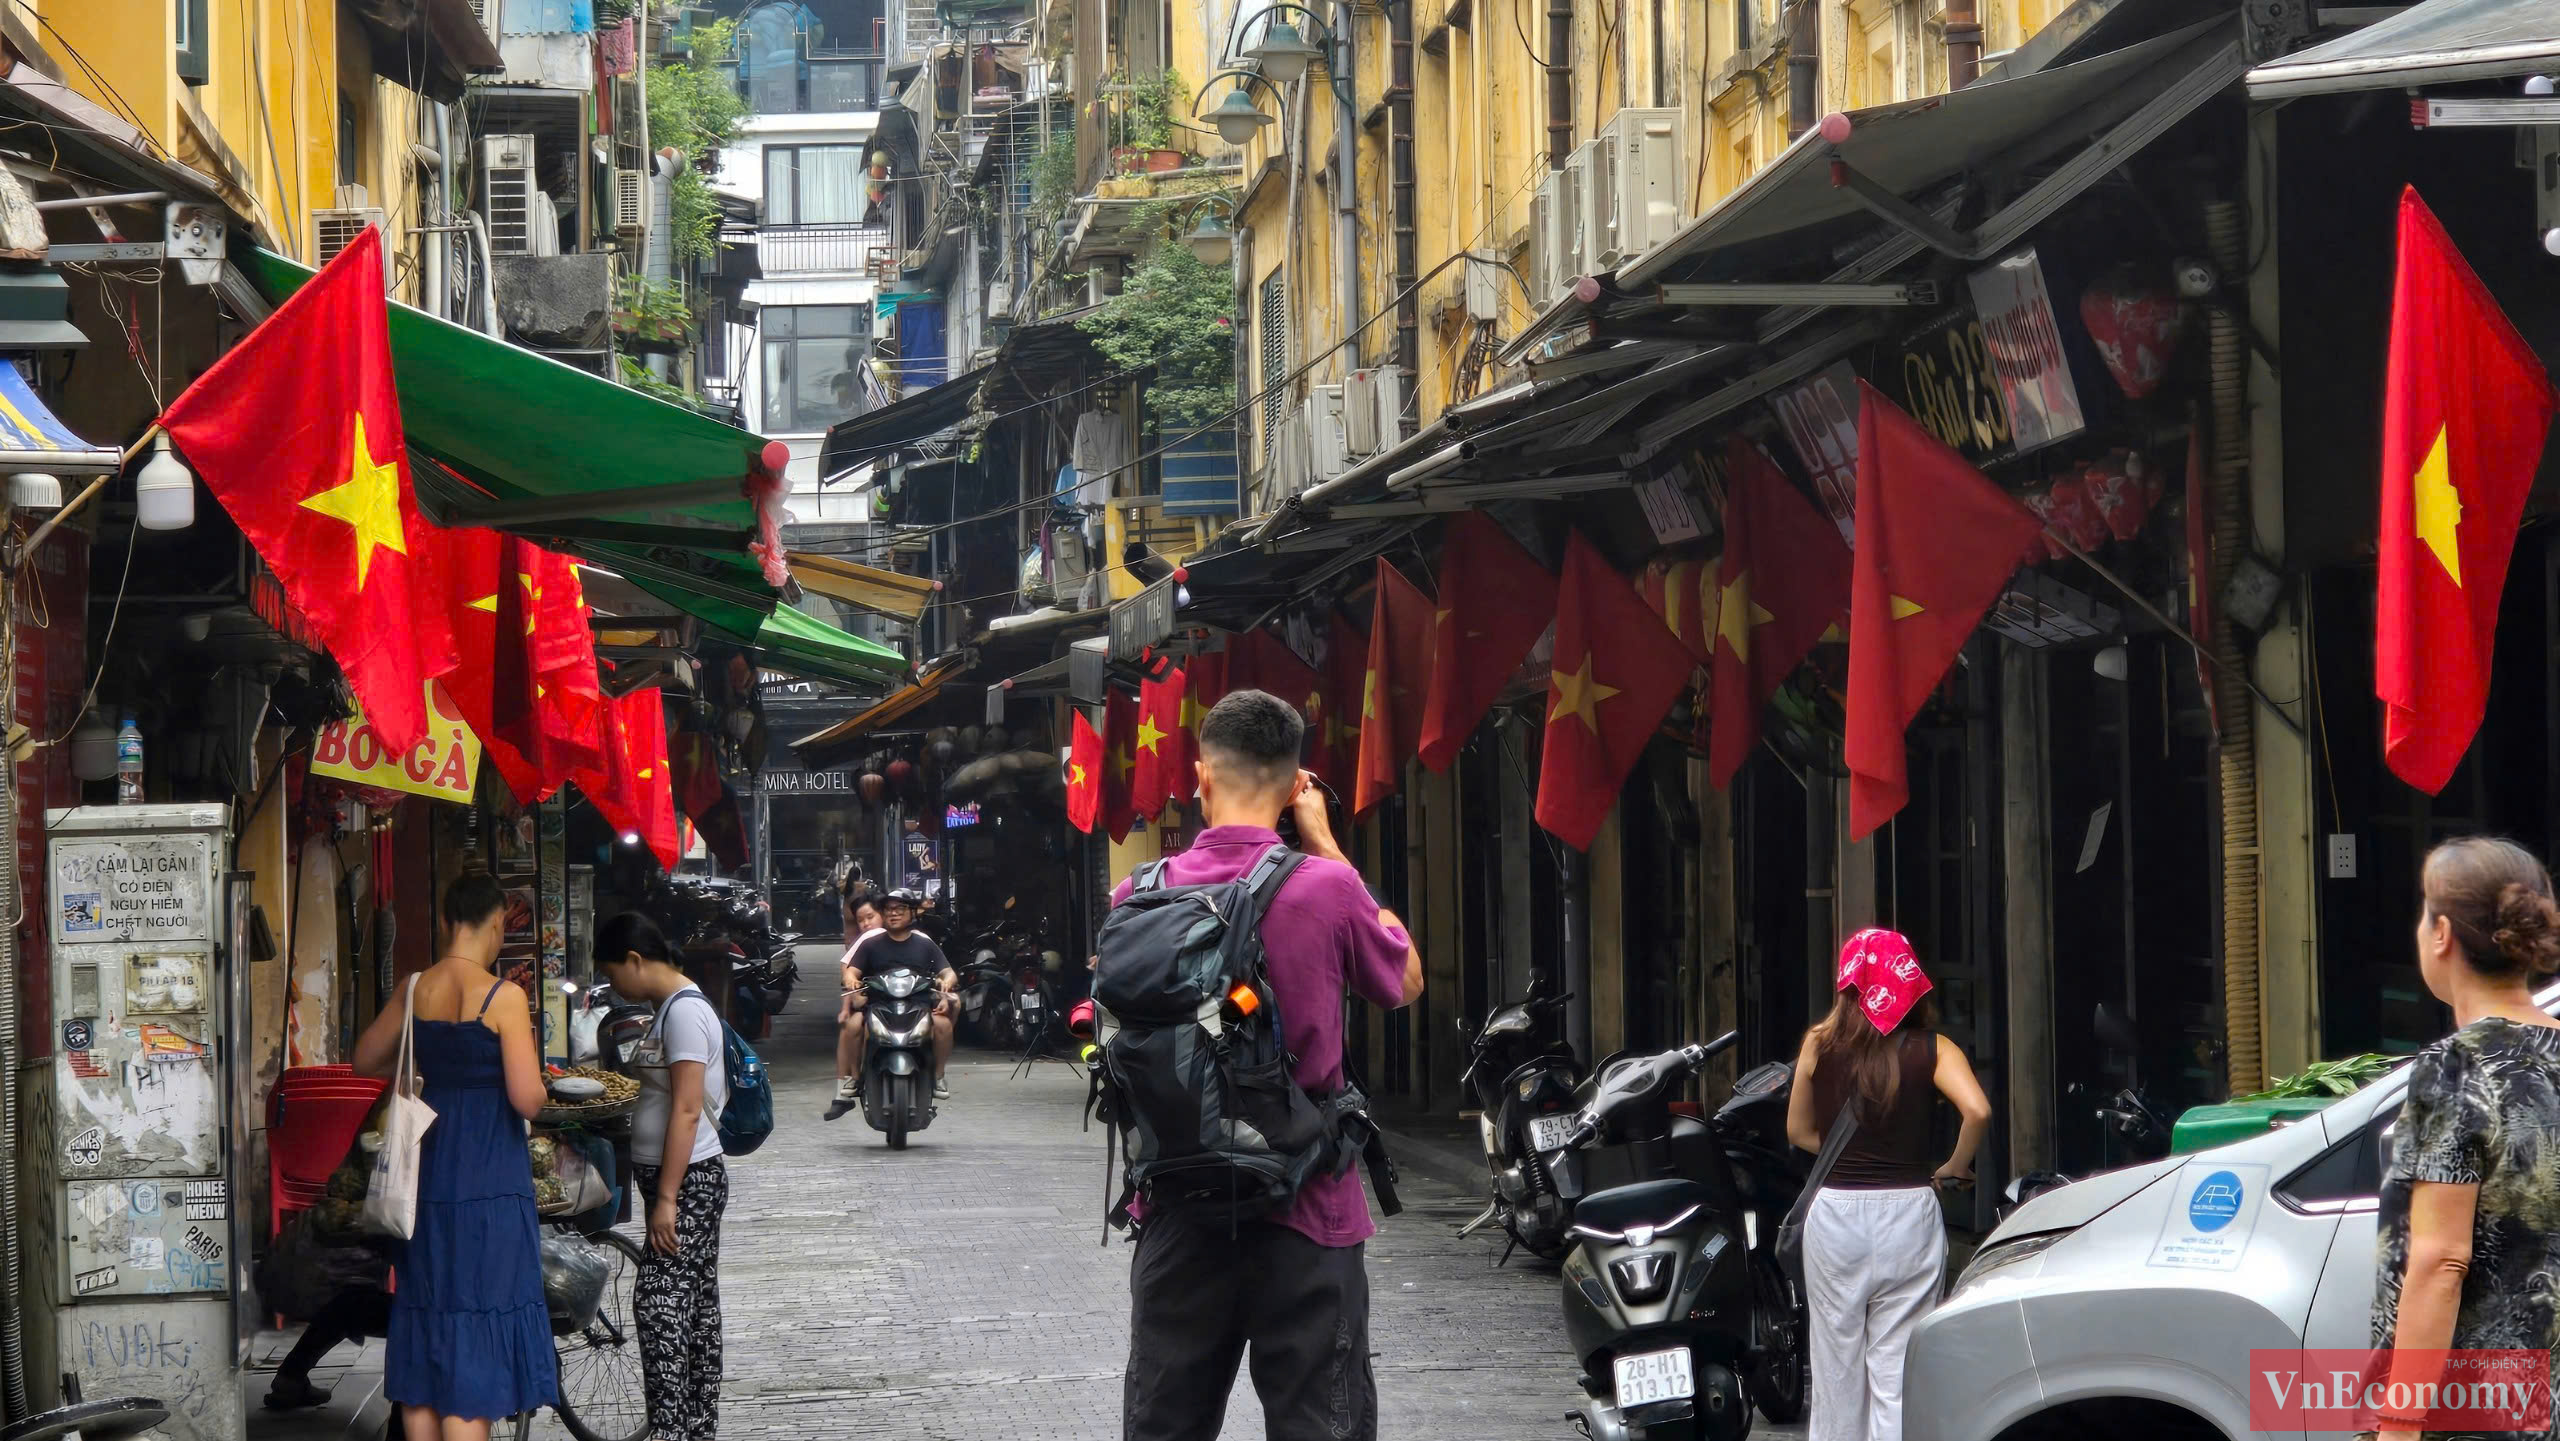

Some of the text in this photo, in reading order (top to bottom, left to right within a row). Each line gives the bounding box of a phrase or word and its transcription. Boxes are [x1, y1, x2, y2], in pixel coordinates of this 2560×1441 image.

[404, 729, 470, 791] GÀ
[764, 772, 848, 790] MINA HOTEL
[132, 858, 153, 877] LẠI
[158, 851, 187, 873] GẦN
[143, 879, 173, 895] ĐIỆN
[110, 899, 148, 911] NGUY
[146, 915, 188, 928] NGƯỜI
[186, 1203, 226, 1220] MEOW
[184, 1225, 223, 1260] PARIS
[1626, 1354, 1679, 1380] 28-H1
[1622, 1376, 1688, 1401] 313.12
